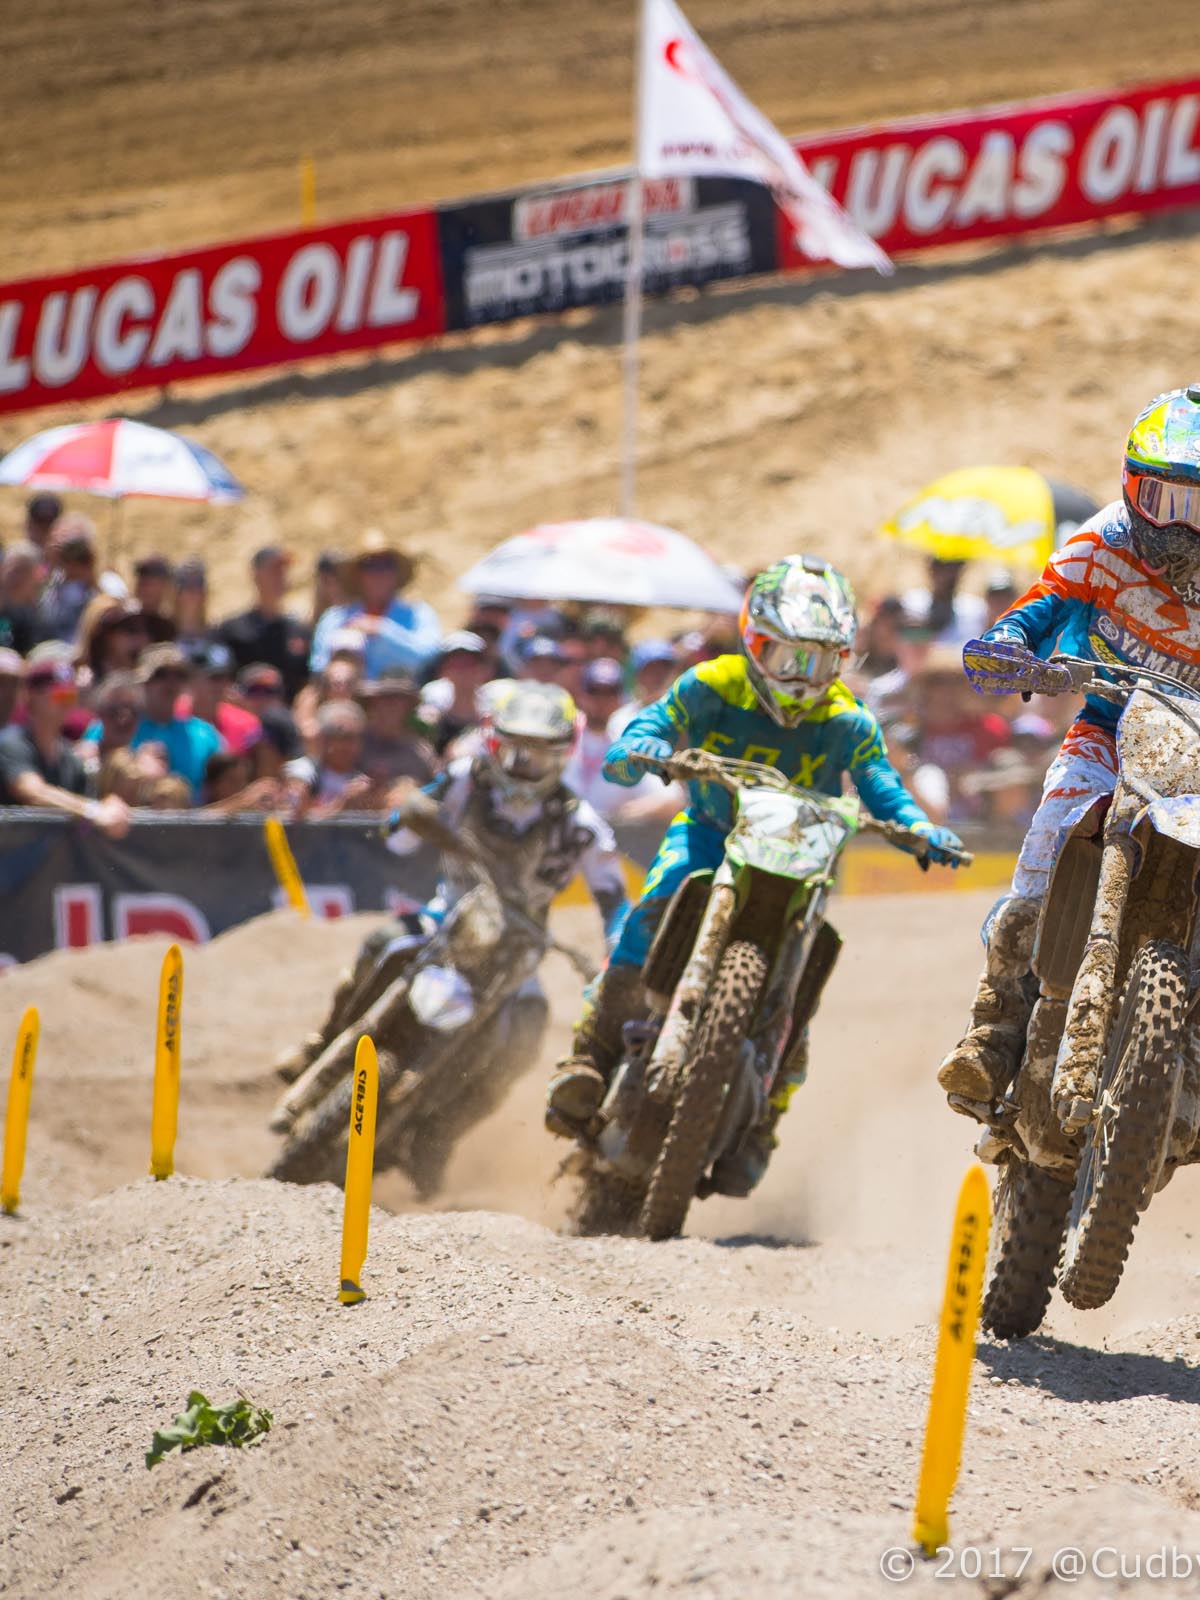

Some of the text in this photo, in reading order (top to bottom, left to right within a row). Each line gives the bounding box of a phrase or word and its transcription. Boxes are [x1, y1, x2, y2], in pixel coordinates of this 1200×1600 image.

[0, 231, 419, 392] LUCAS OIL
[702, 730, 828, 788] FOX
[355, 1068, 368, 1136] ACERBIS
